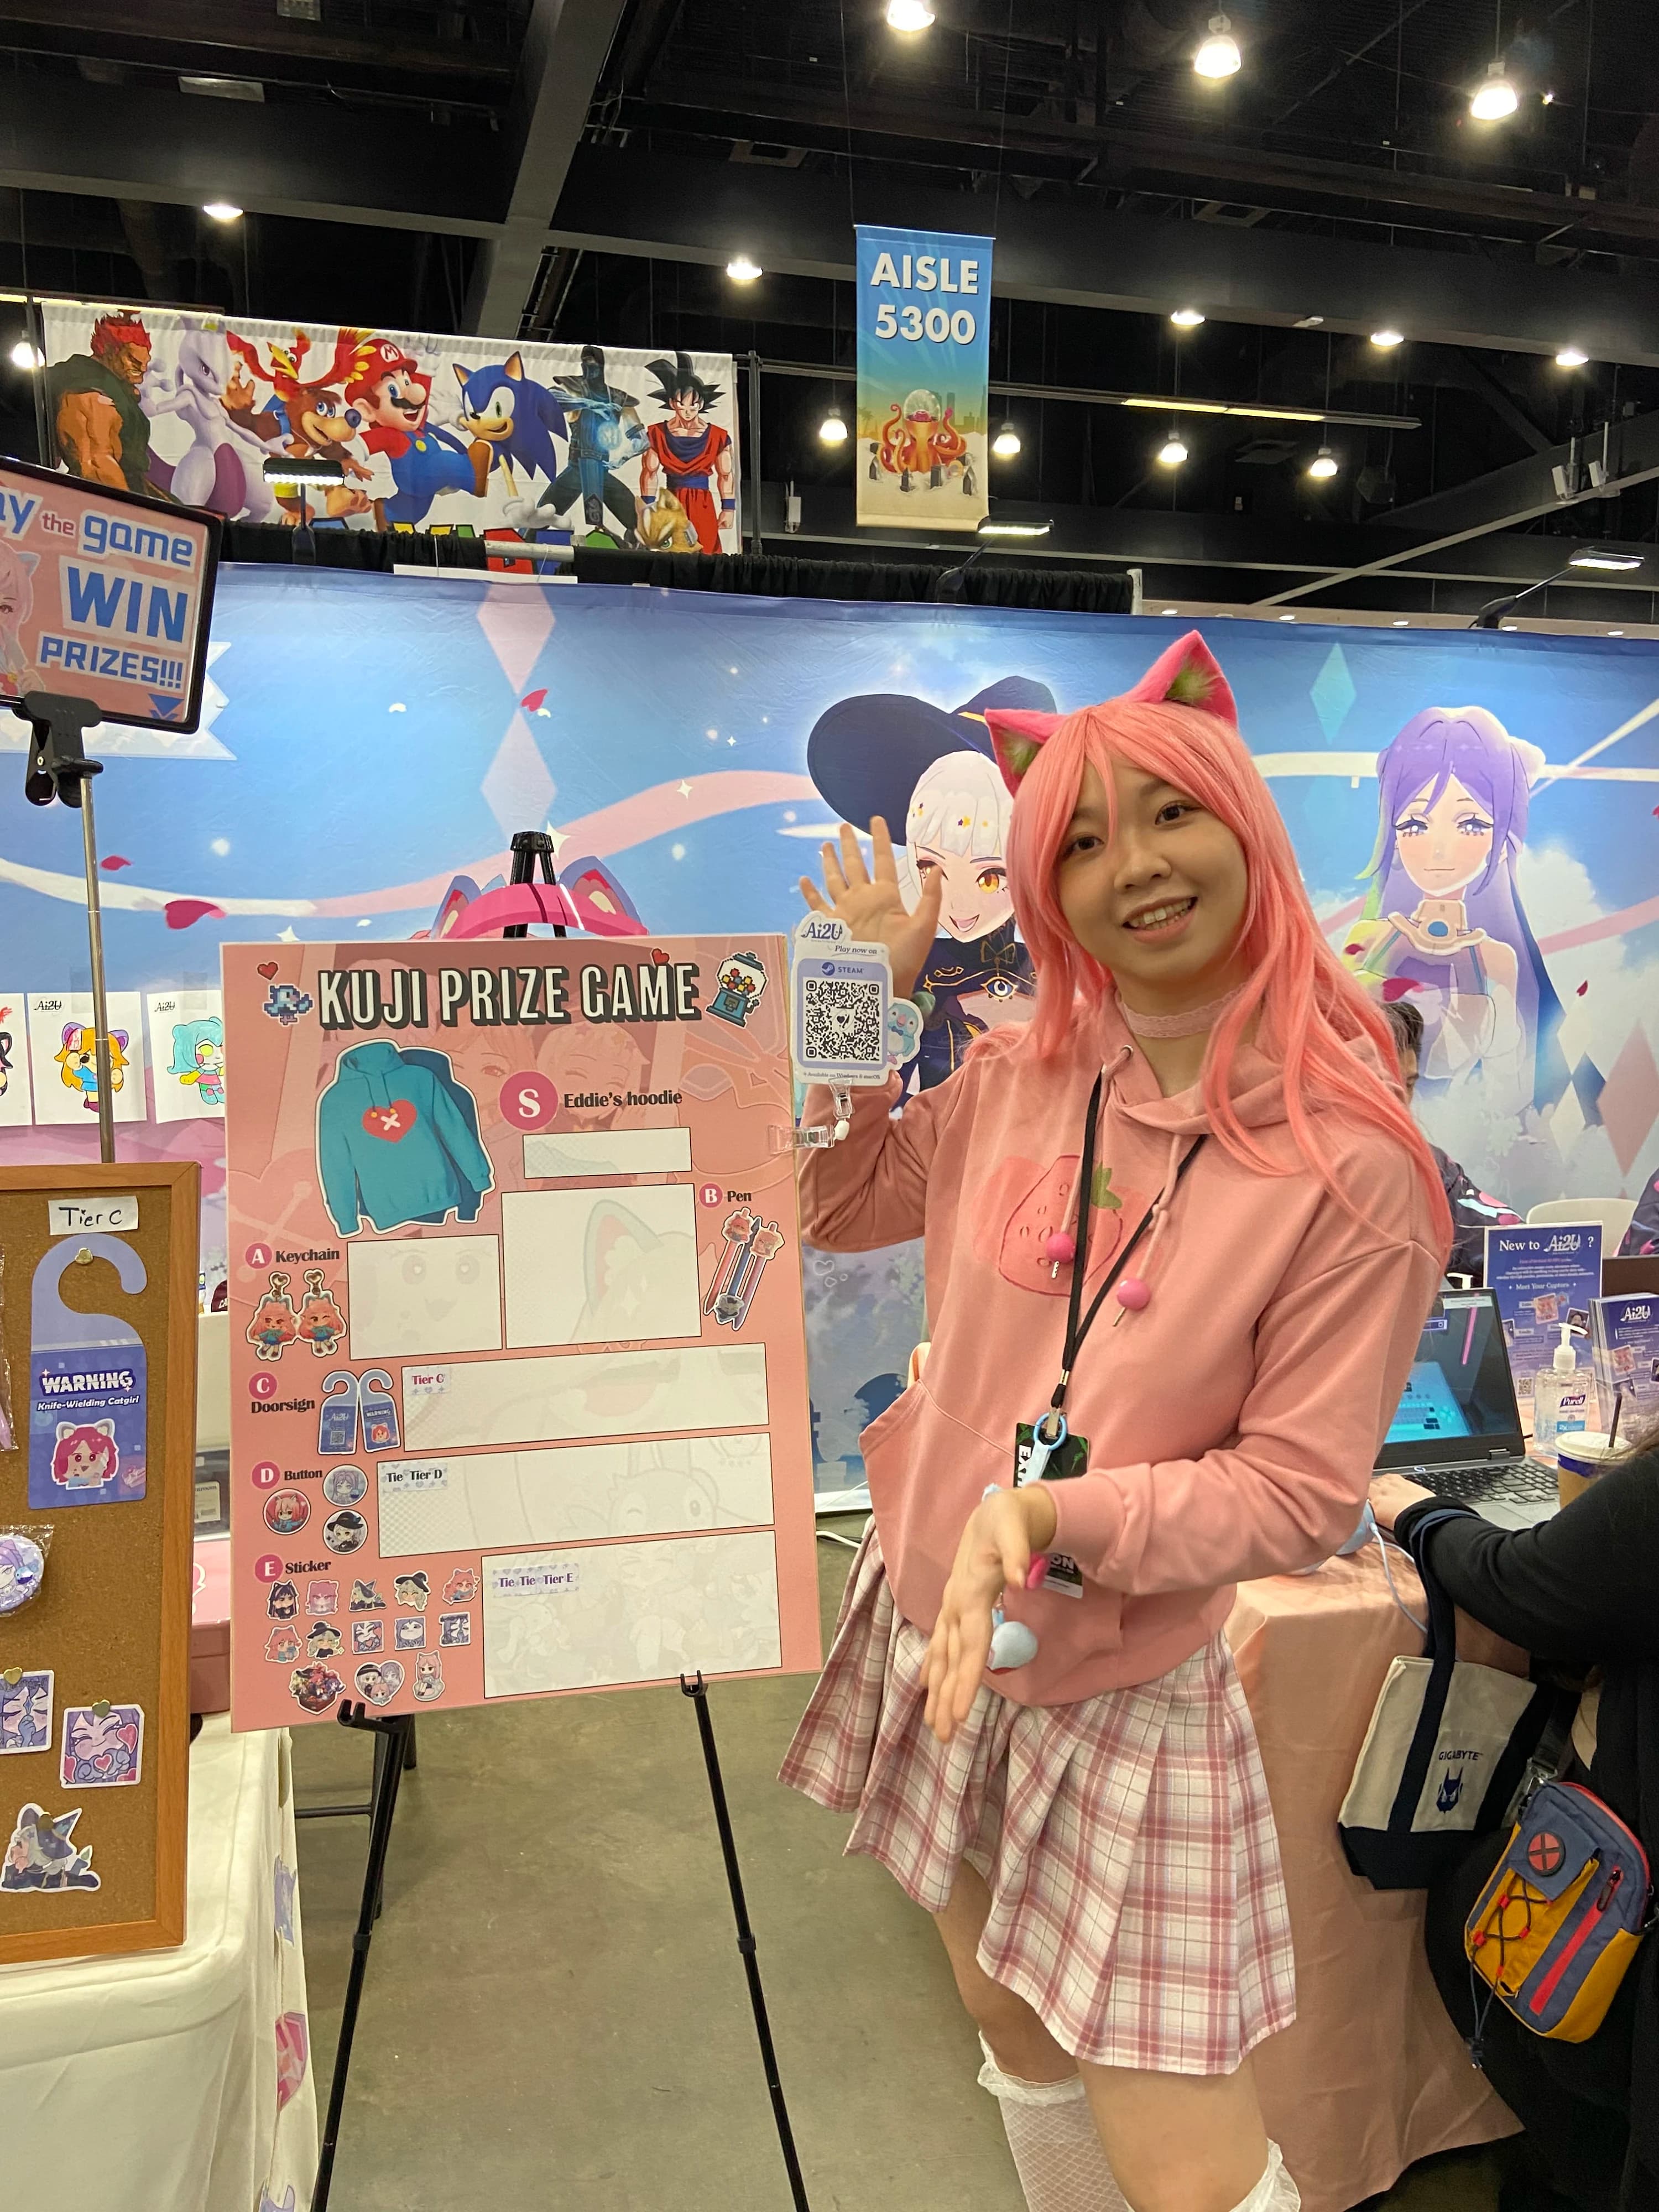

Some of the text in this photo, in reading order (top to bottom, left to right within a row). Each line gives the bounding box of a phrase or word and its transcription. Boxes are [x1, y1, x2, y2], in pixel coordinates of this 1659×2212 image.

[870, 253, 978, 294] AISLE
[875, 304, 975, 345] 5300
[42, 513, 74, 535] the
[84, 515, 192, 567] game
[67, 566, 188, 643] WIN
[40, 636, 183, 689] PRIZES!!!
[801, 922, 843, 940] Ai2U
[834, 945, 851, 953] Play
[318, 963, 702, 1029] KUJI PRIZE GAME
[518, 1088, 682, 1118] S Eddie's hoodie
[705, 1188, 752, 1203] B Pen
[59, 1207, 122, 1226] Tier C
[1499, 1240, 1525, 1251] New
[1529, 1241, 1540, 1250] to
[1543, 1234, 1580, 1252] Ai2U
[252, 1249, 340, 1264] A Keychain
[1620, 1305, 1650, 1321] Ai2U
[42, 1371, 133, 1394] WARNING
[257, 1378, 269, 1393] C
[411, 1374, 444, 1385] Tier C
[38, 1395, 139, 1410] Knife-Wielding Catgirl
[251, 1399, 315, 1413] Doorsign
[1563, 1396, 1584, 1405] Purell
[260, 1468, 322, 1483] D Button
[386, 1469, 442, 1482] Tie Tier D
[264, 1559, 331, 1576] E Sticker
[543, 1574, 564, 1584] Tier
[567, 1573, 573, 1582] E
[1438, 1750, 1479, 1760] GIGABYTE
